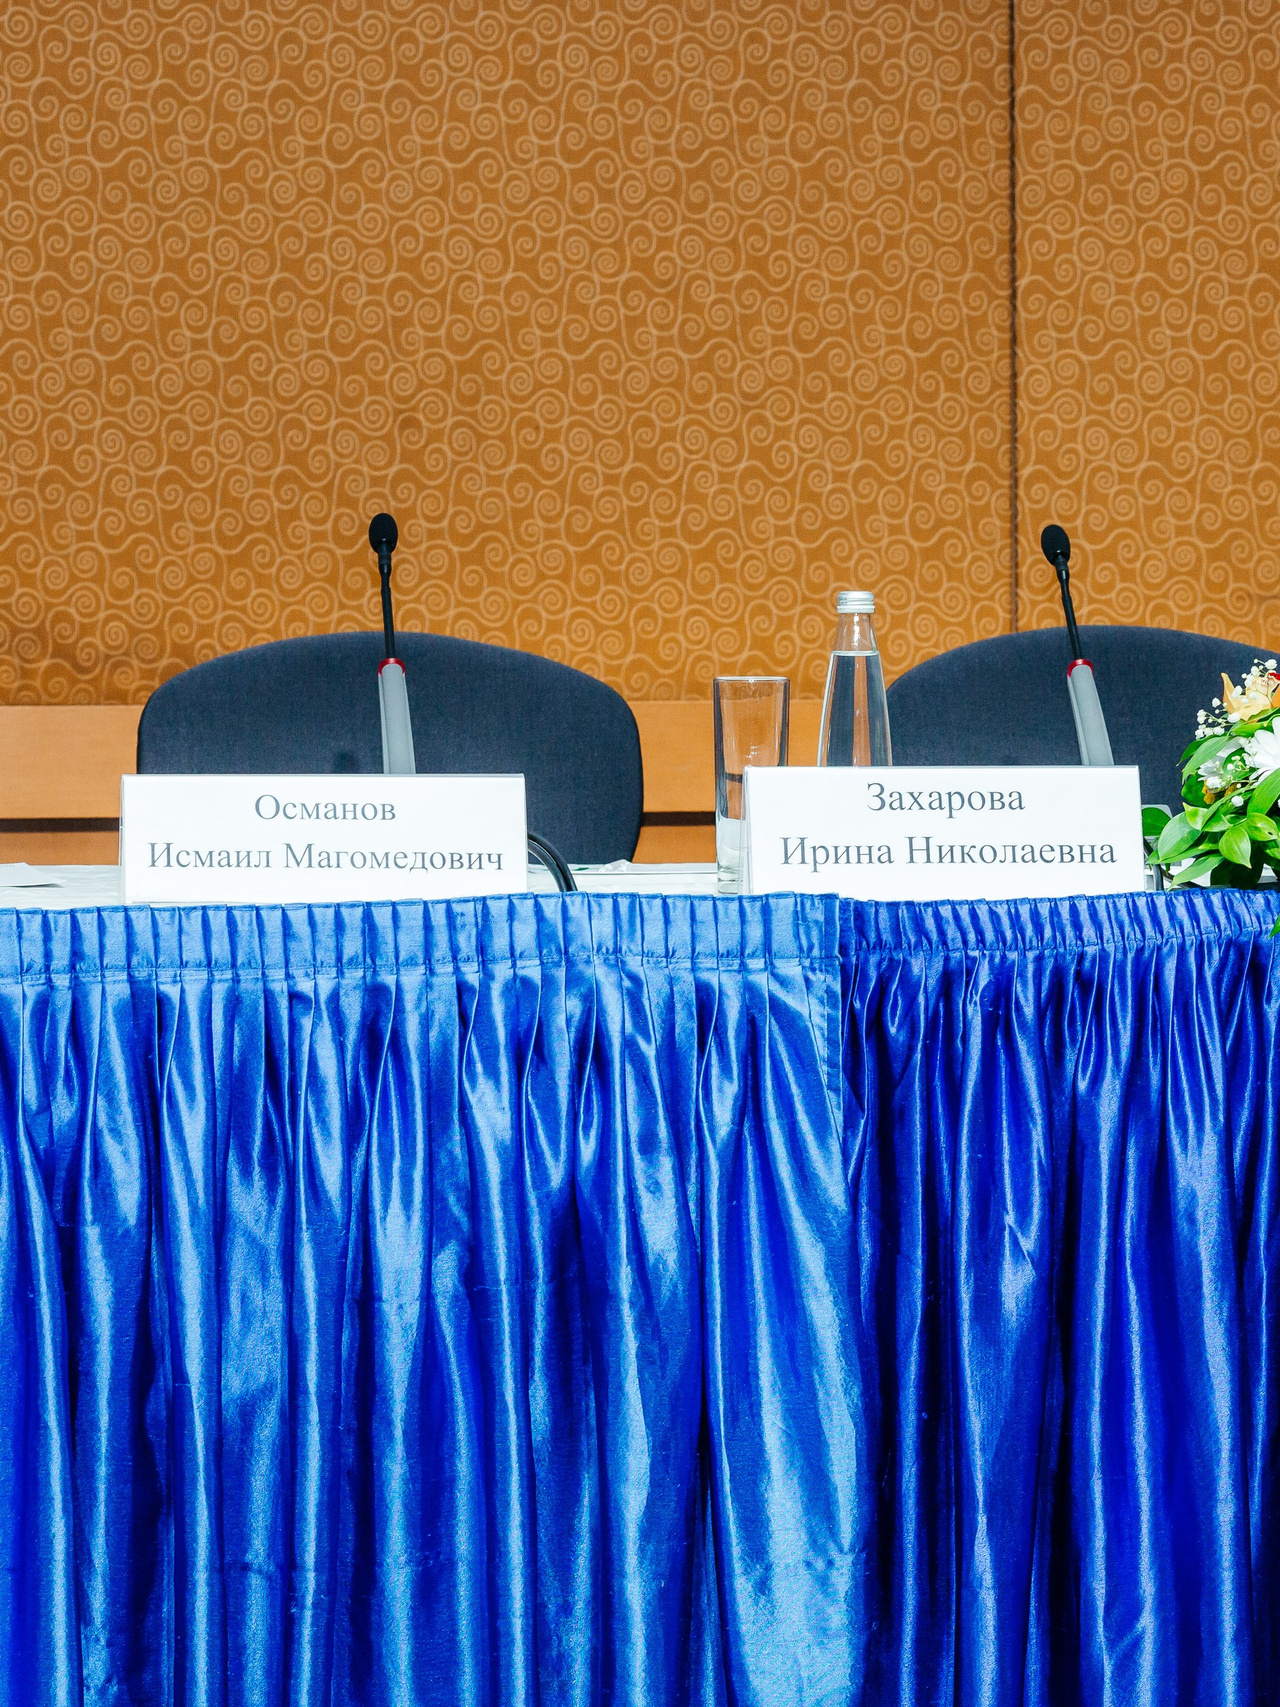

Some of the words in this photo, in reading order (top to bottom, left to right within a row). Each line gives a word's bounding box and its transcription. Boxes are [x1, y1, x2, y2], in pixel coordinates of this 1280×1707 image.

[255, 795, 395, 820] Османов
[868, 783, 1025, 818] Захарова
[149, 843, 270, 868] Исмаил
[285, 844, 503, 872] Магомедович
[782, 837, 894, 872] Ирина
[906, 837, 1117, 863] Николаевна
